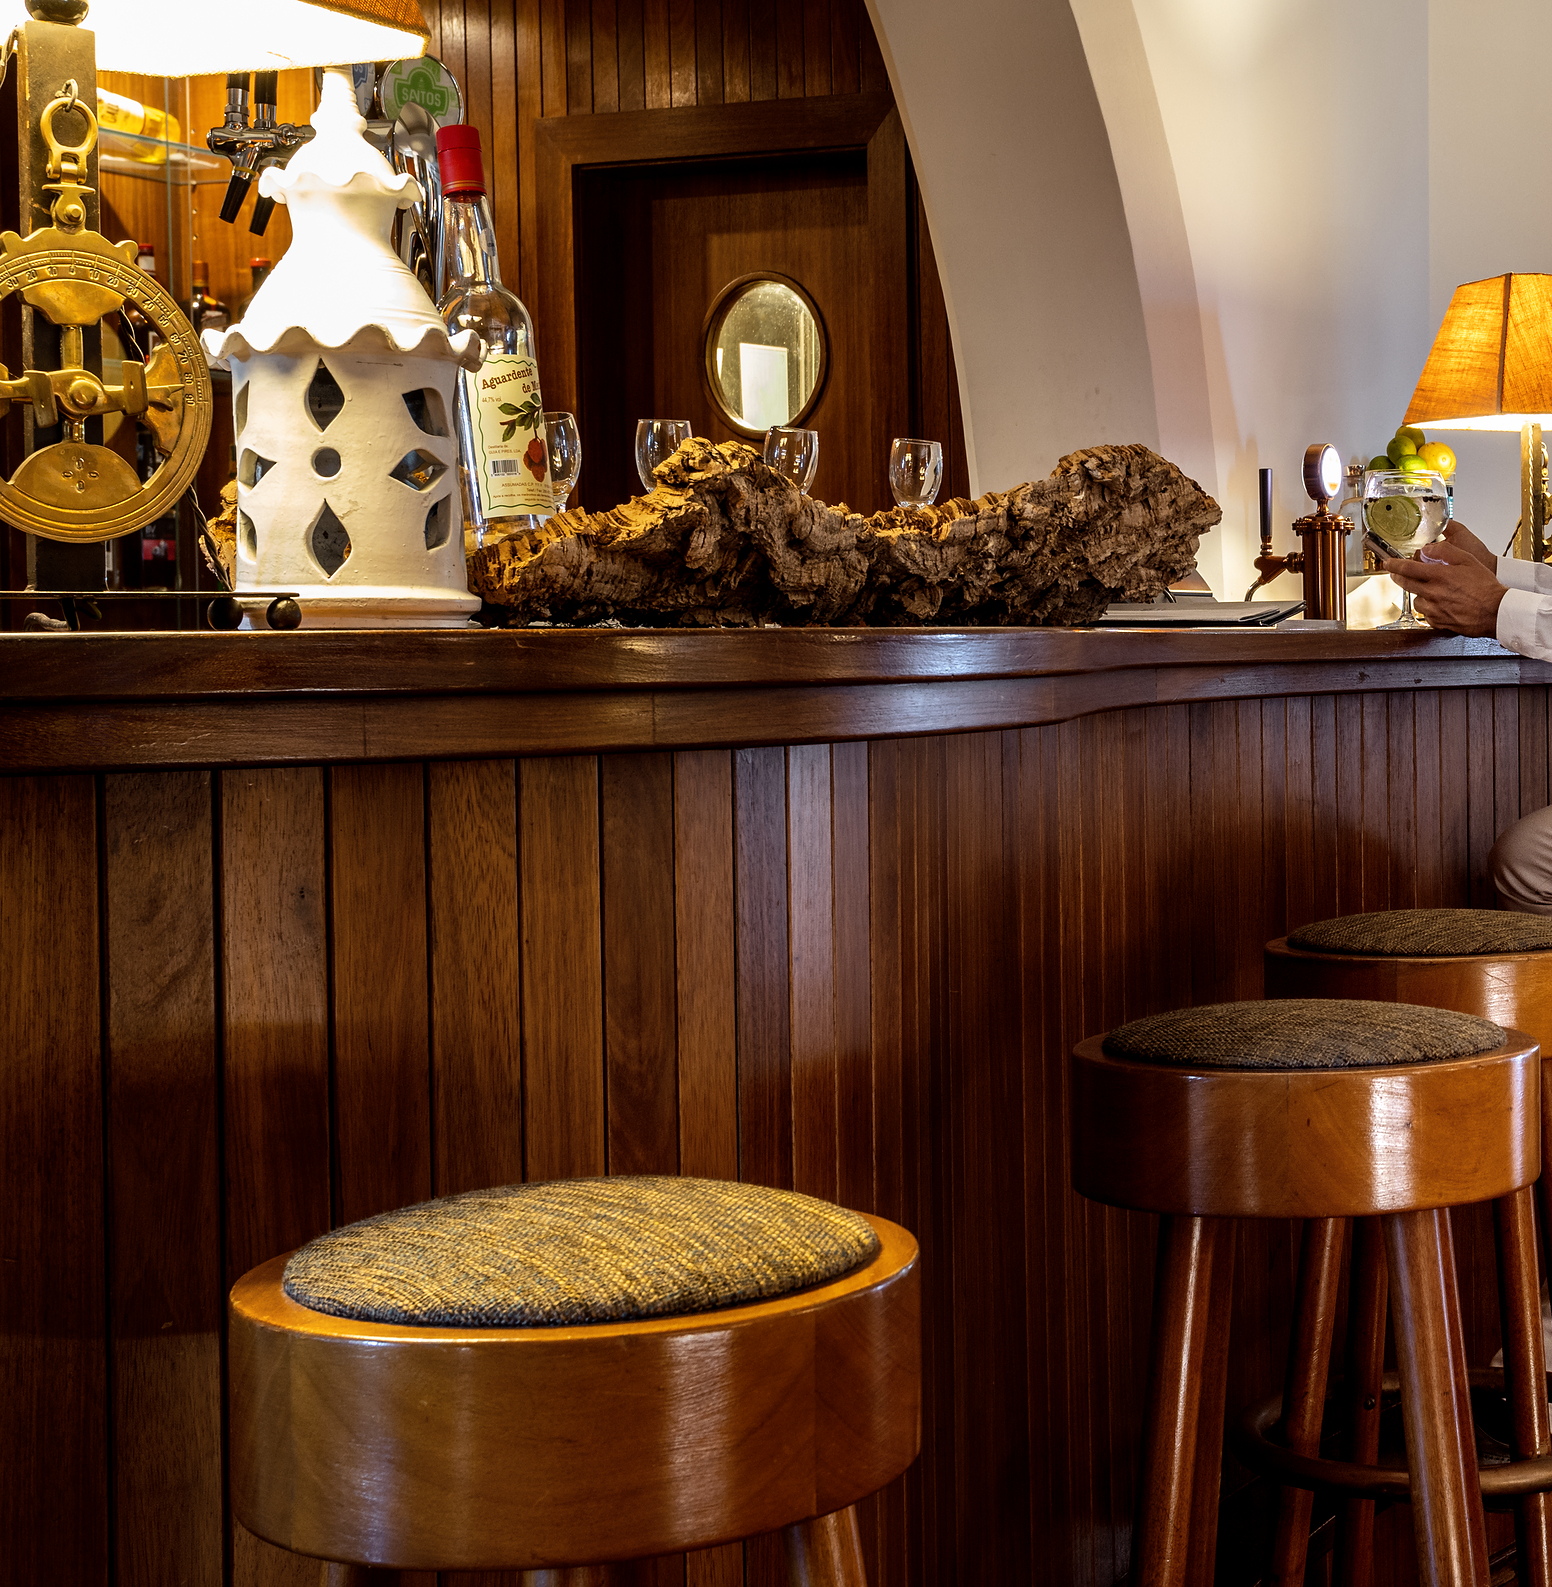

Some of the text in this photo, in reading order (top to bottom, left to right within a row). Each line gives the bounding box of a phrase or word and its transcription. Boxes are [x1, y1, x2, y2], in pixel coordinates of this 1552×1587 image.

[26, 269, 38, 282] 20
[46, 266, 58, 277] 10
[89, 268, 100, 280] 10
[6, 276, 19, 290] 30
[107, 275, 119, 288] 20
[126, 286, 139, 298] 30
[142, 299, 155, 312] 40
[158, 315, 170, 328] 50
[170, 333, 181, 346] 60
[177, 350, 189, 364] 70
[184, 372, 194, 385] 80
[482, 367, 533, 390] Aguardente
[522, 383, 531, 393] de
[185, 394, 196, 406] 90
